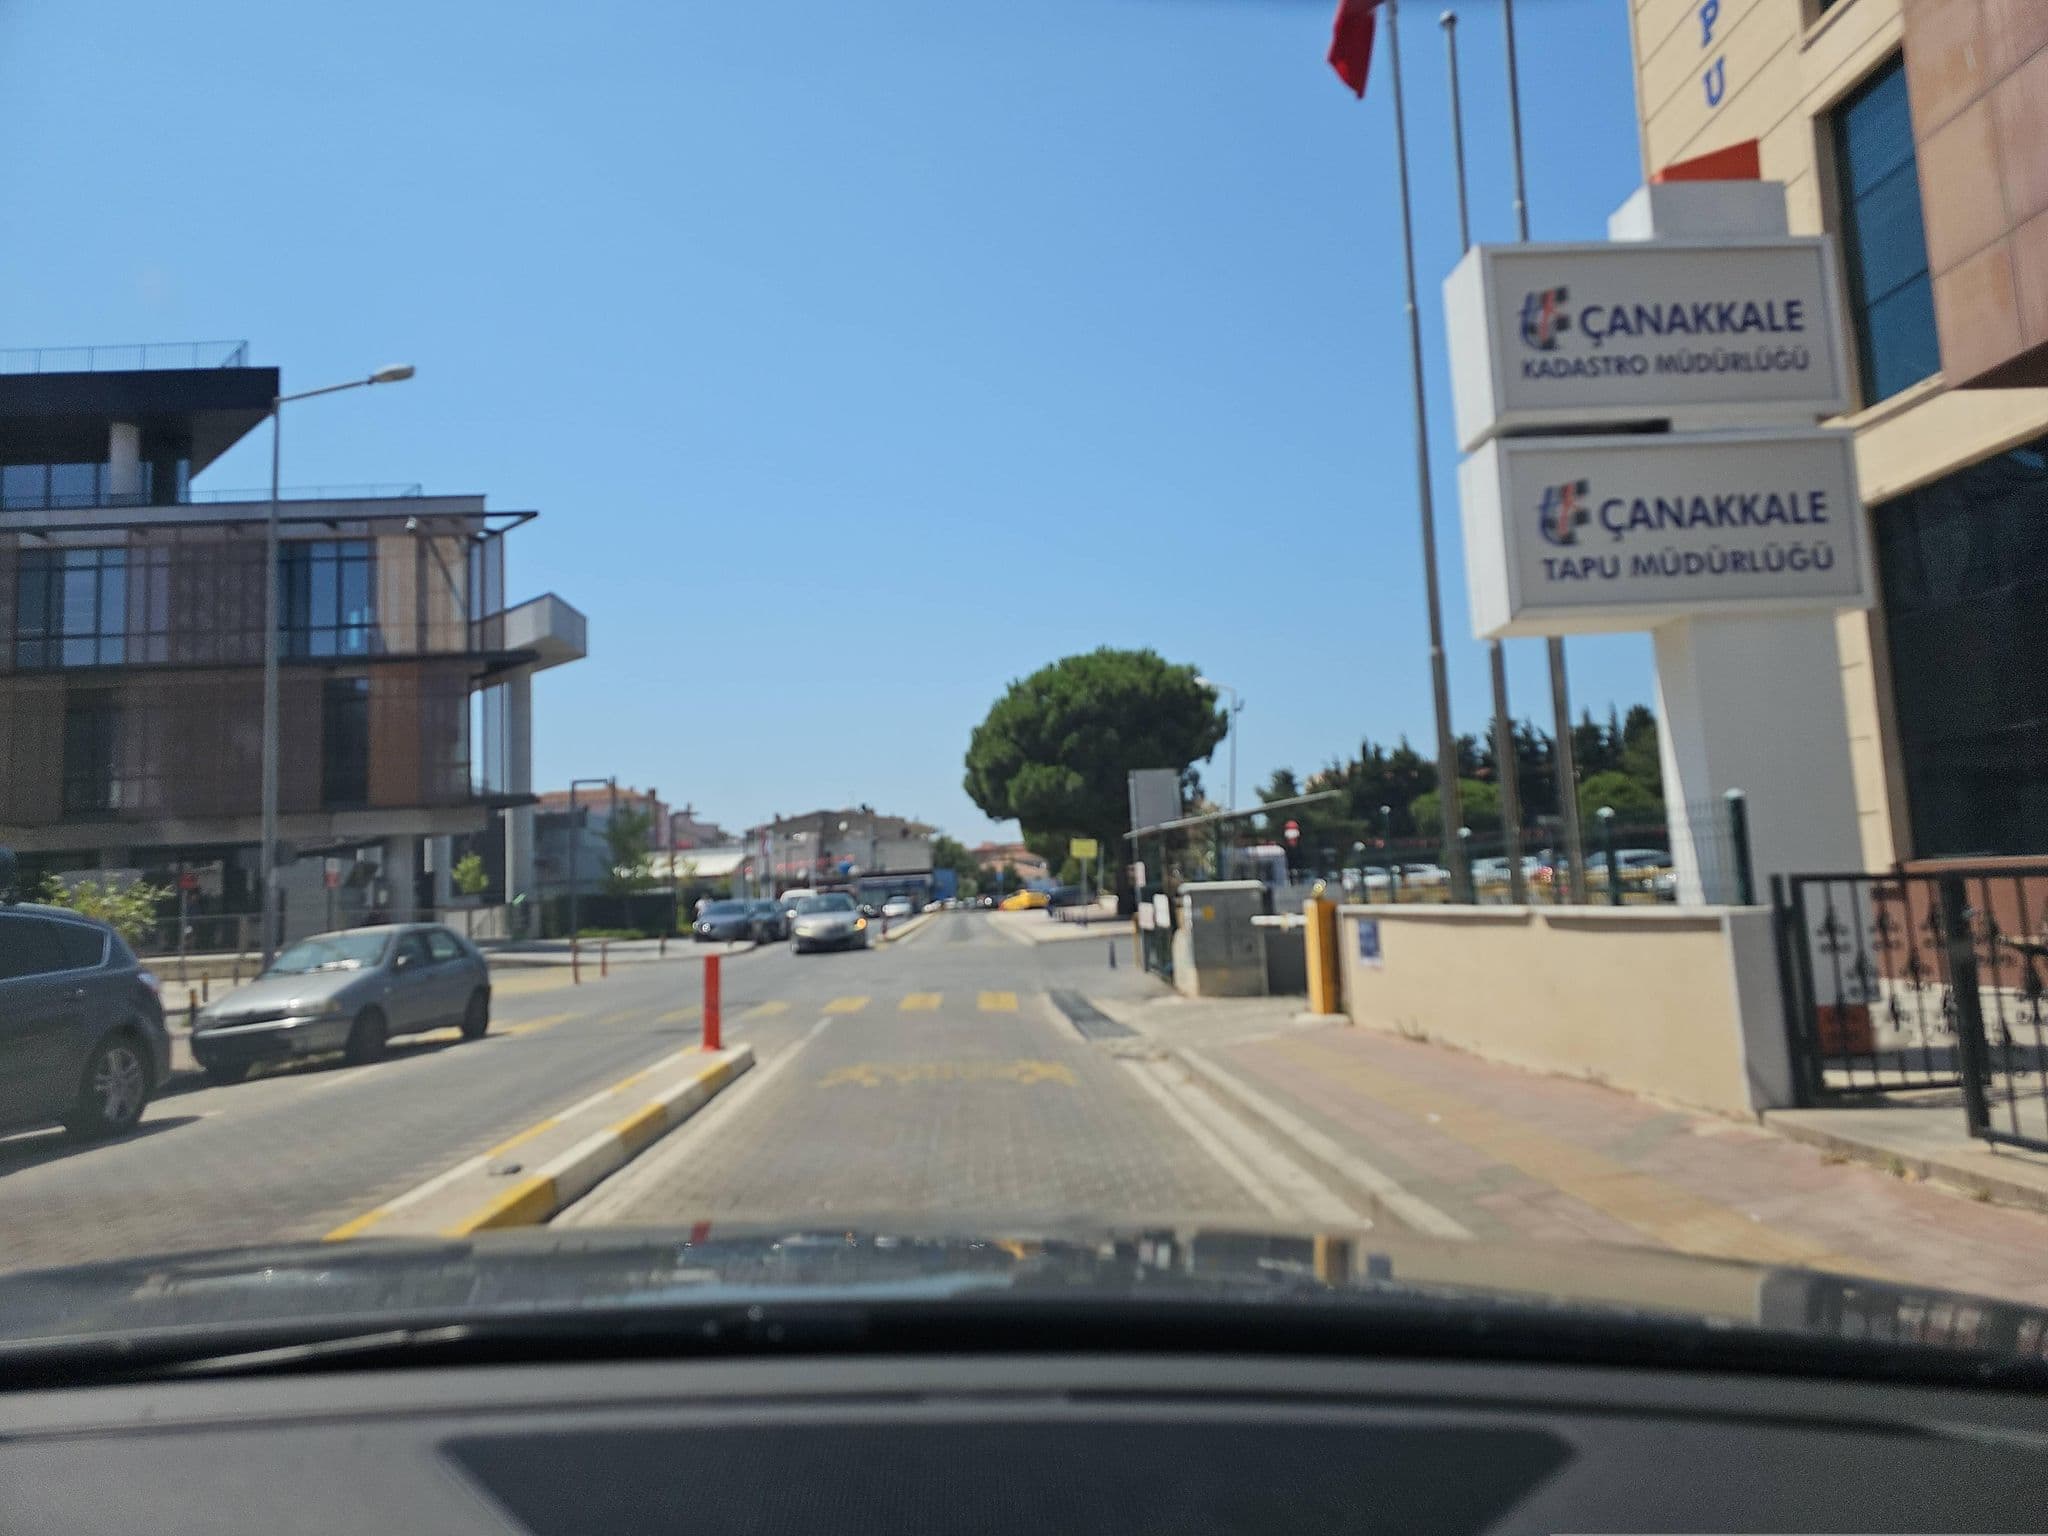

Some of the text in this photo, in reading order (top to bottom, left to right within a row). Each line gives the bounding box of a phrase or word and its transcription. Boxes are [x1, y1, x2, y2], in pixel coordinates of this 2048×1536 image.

[1580, 300, 1805, 347] ÇANAKKALE
[1523, 345, 1810, 379] KADASTRO MÜDÜRLÜĞÜ
[1601, 490, 1829, 542] ÇANAKKALE
[1543, 541, 1834, 581] TAPU MÜDÜRLÜĞÜ
